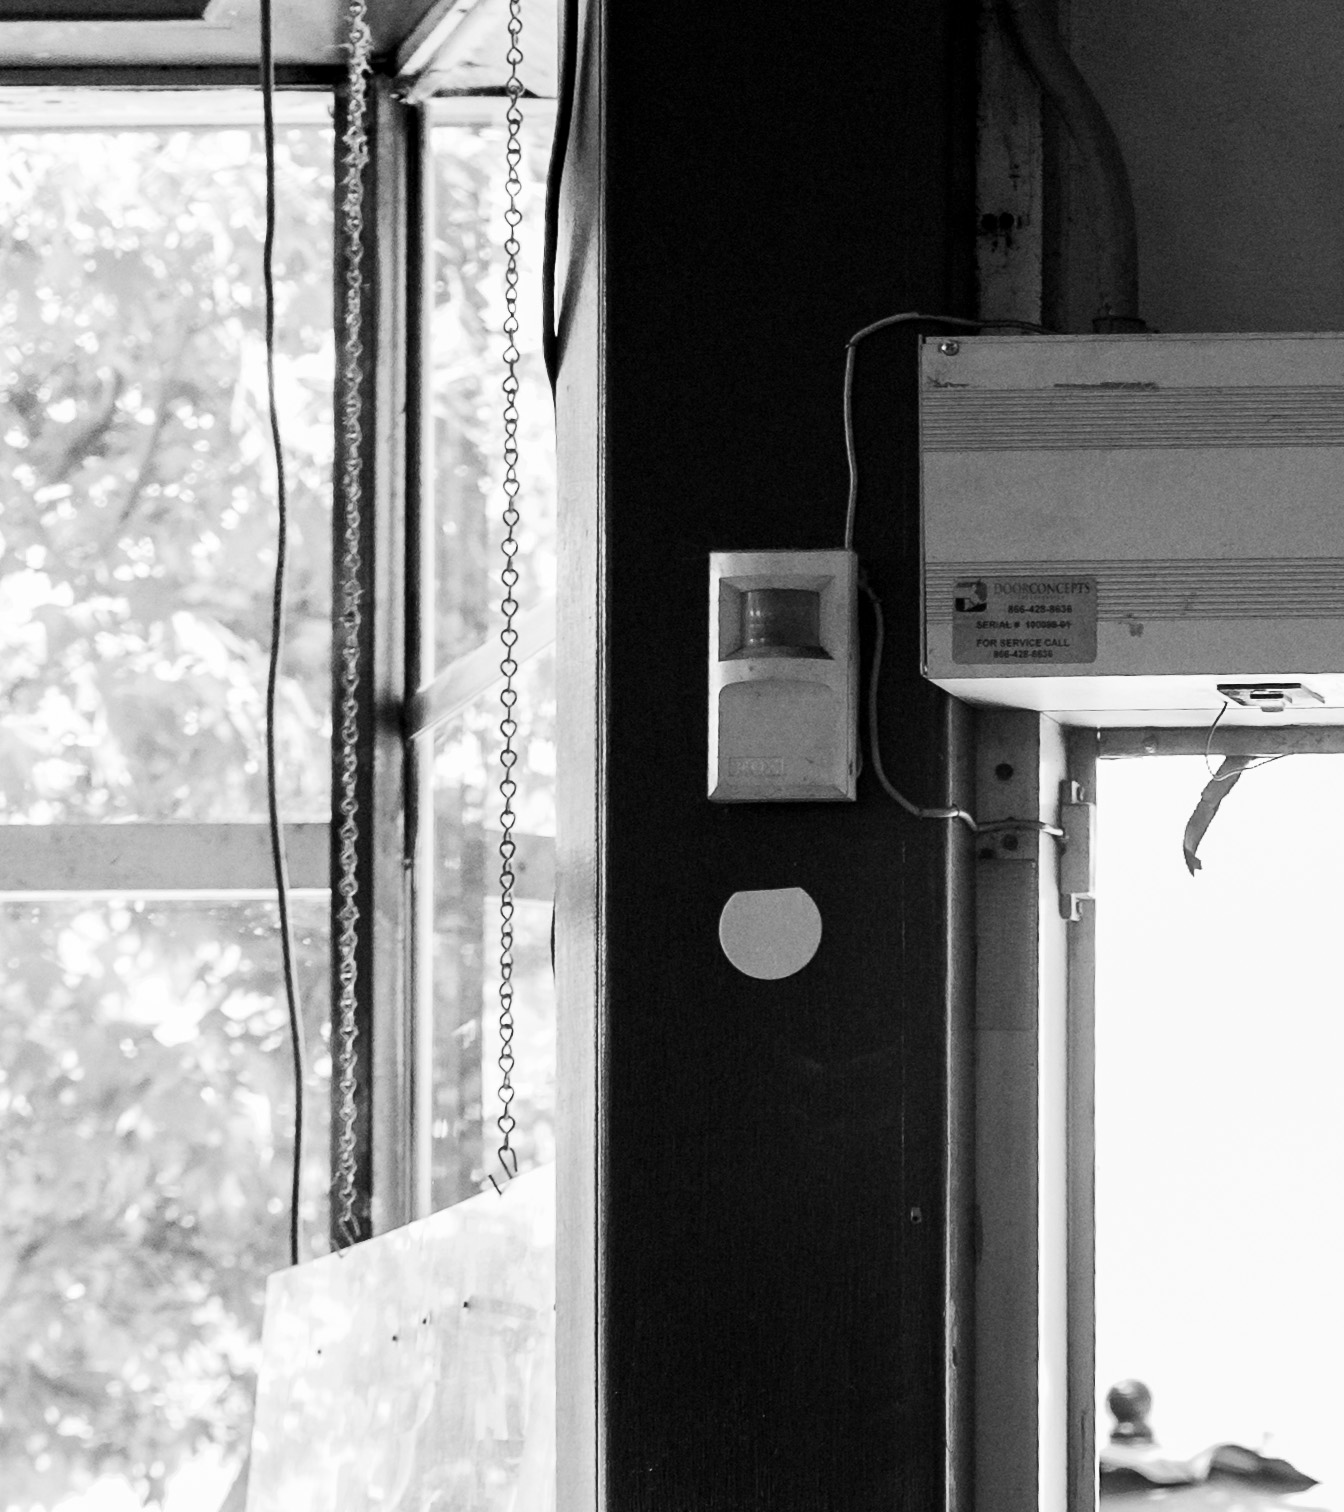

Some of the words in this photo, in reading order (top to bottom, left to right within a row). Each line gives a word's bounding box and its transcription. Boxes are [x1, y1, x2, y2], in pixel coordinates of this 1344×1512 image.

[976, 620, 1011, 630] SERIAL
[976, 638, 998, 648] FOR
[1000, 638, 1042, 648] SERVICE
[1044, 638, 1071, 648] CALL
